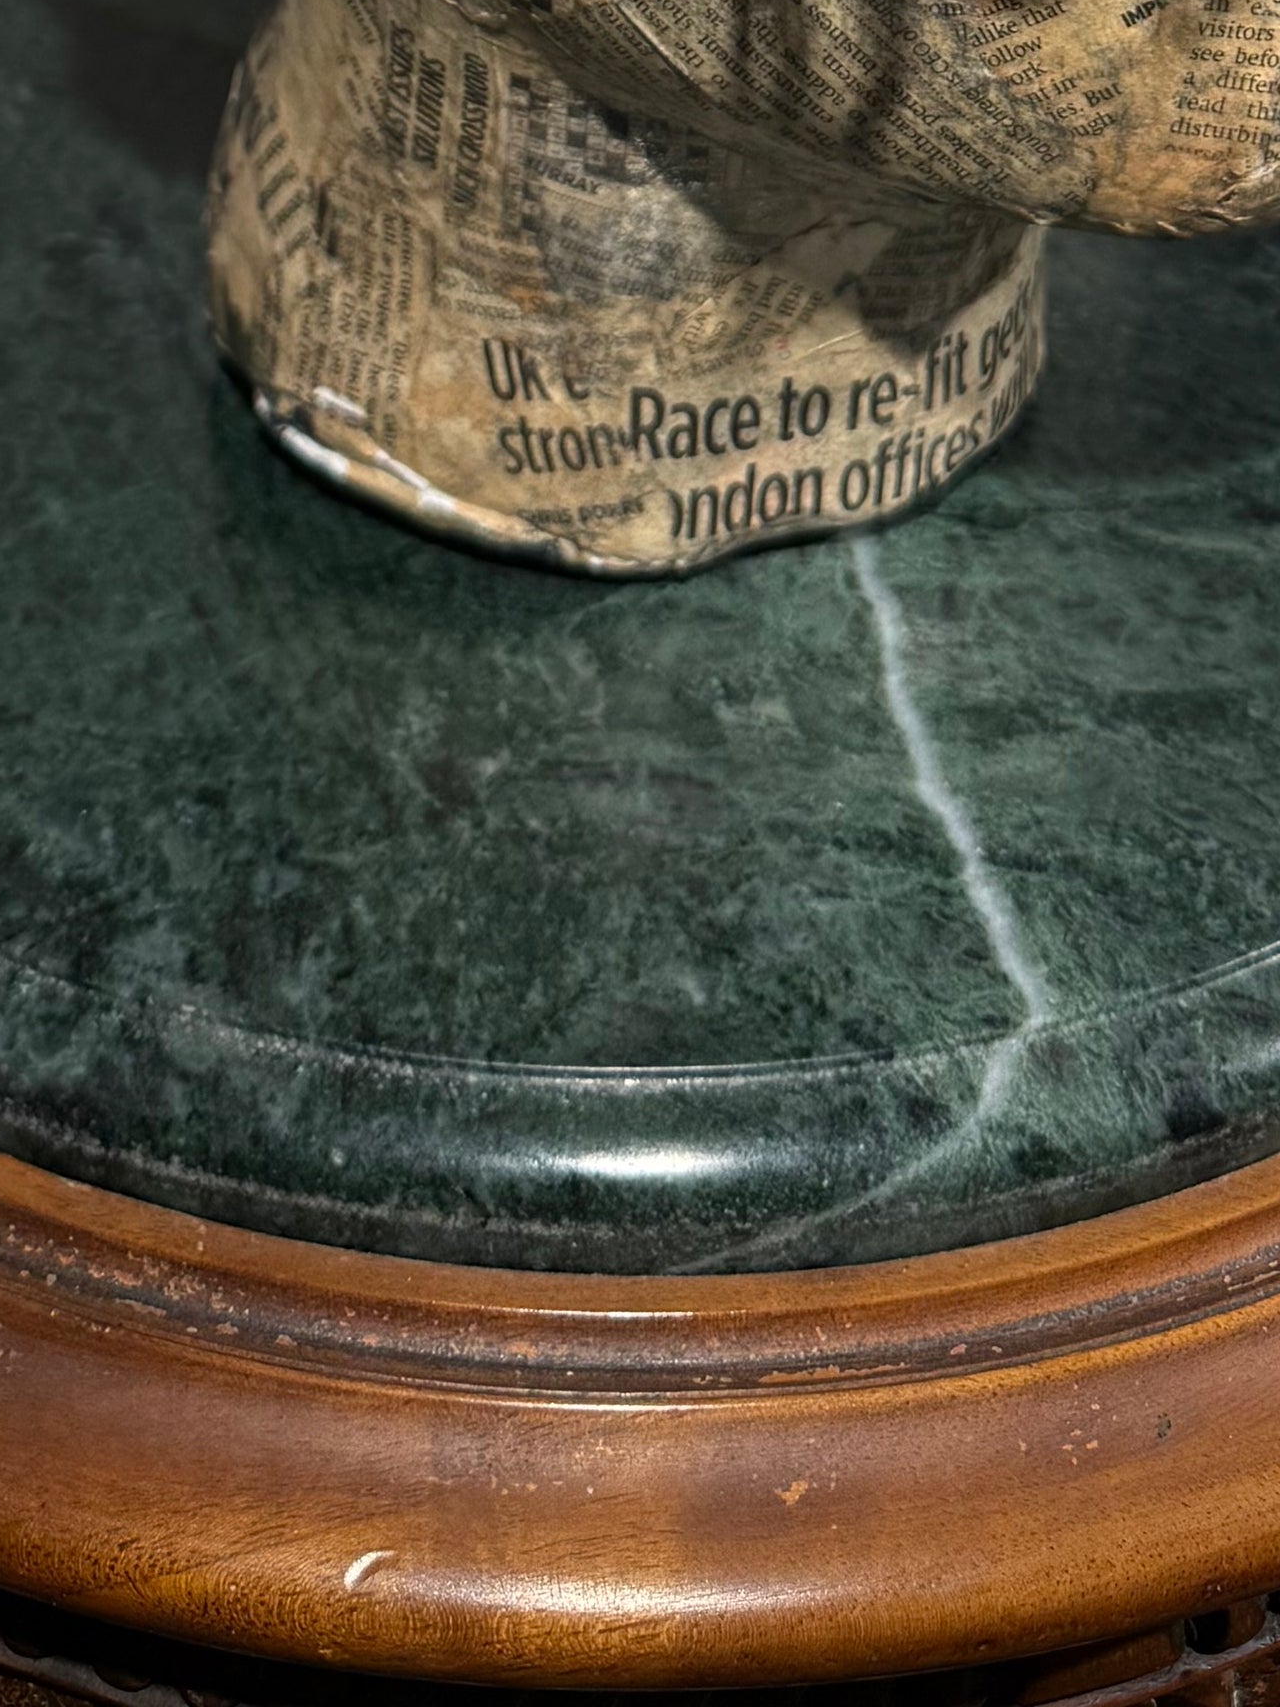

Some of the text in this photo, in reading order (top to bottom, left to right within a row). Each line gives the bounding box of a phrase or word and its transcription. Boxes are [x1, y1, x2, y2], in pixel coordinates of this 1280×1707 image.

[698, 3, 726, 30] as
[798, 0, 880, 78] business
[1021, 0, 1067, 28] that
[1198, 19, 1275, 42] visitors
[670, 35, 706, 71] the
[694, 26, 803, 129] government
[707, 70, 731, 93] to
[732, 33, 834, 130] enthusiasm
[776, 44, 847, 112] address
[813, 44, 883, 111] system.
[909, 36, 952, 78] CEO
[979, 36, 1043, 69] follow
[1188, 46, 1224, 62] see
[403, 48, 453, 170] SOLUTIONS
[448, 51, 496, 164] CROSSWORD
[872, 65, 942, 132] perfect
[1054, 75, 1076, 95] in
[1083, 81, 1124, 108] But
[1174, 93, 1226, 114] read
[867, 121, 911, 164] how
[876, 97, 973, 189] healthcare
[934, 119, 995, 177] makes
[1015, 125, 1061, 170] Paul
[483, 338, 552, 401] UK
[629, 330, 968, 460] Race to re-fit
[497, 415, 621, 475] stron
[839, 412, 983, 512] offices
